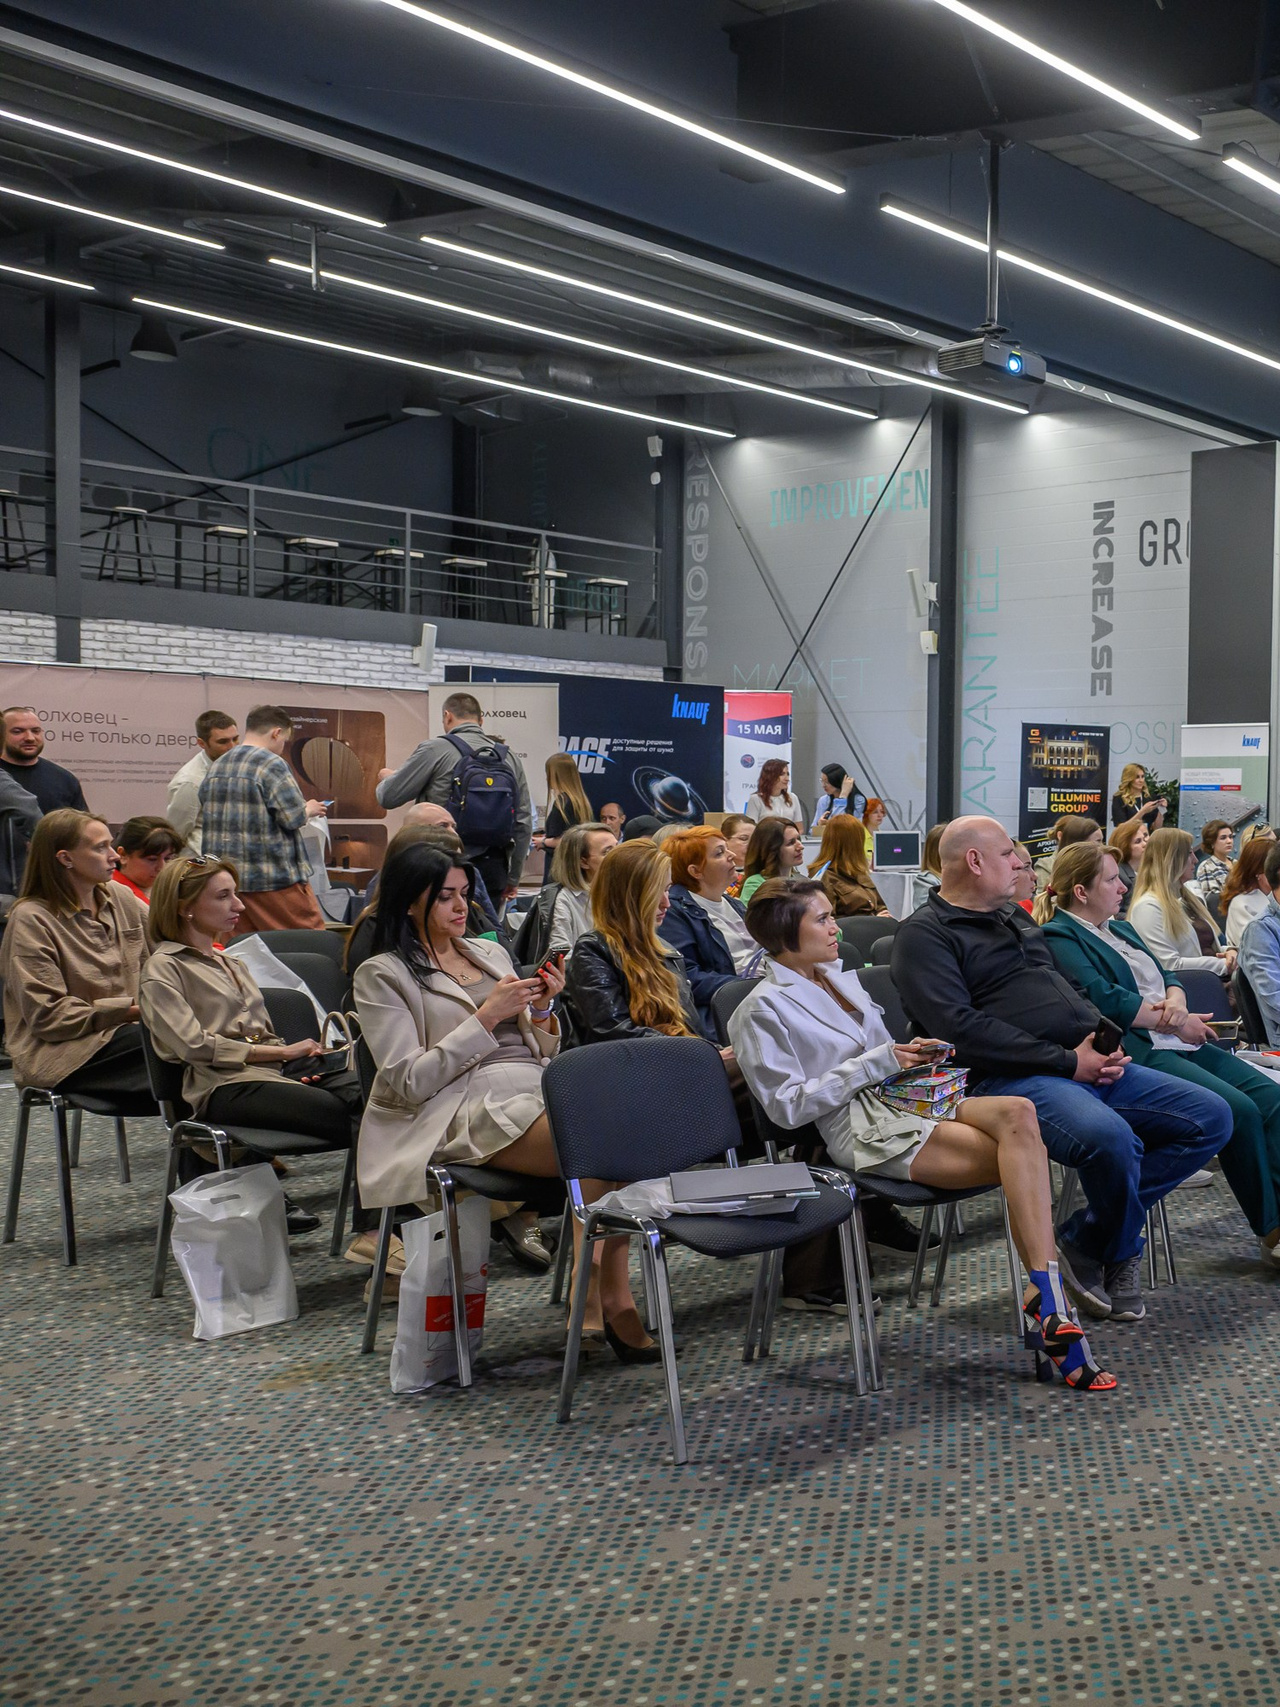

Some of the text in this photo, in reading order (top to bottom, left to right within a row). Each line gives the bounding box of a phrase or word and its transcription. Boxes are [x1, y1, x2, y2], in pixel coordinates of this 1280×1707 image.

[768, 468, 929, 528] IMPROVEMEN
[1138, 517, 1190, 568] GR
[1090, 500, 1115, 698] INCREASE
[961, 546, 998, 815] ARANTEE
[61, 730, 84, 742] не
[89, 731, 151, 744] только
[155, 734, 198, 749] двер
[612, 738, 673, 747] доступные решения
[737, 724, 782, 736] 15 МАЯ
[1109, 720, 1175, 756] OSSI
[1051, 793, 1100, 803] ILLUMINE
[1051, 804, 1089, 813] GROUP
